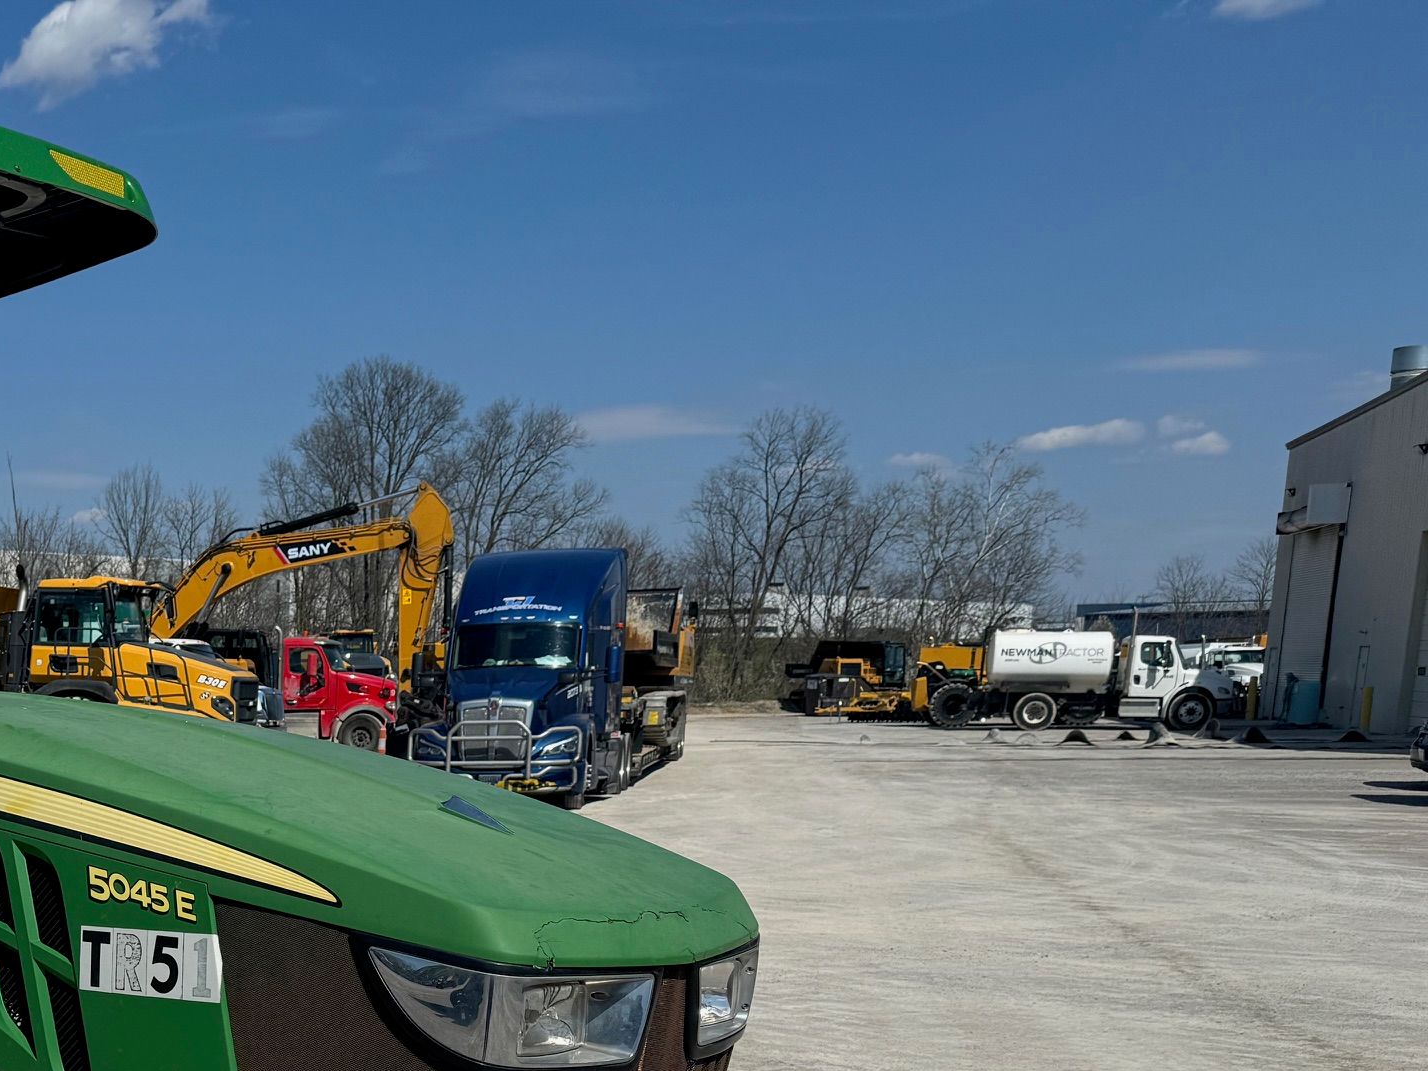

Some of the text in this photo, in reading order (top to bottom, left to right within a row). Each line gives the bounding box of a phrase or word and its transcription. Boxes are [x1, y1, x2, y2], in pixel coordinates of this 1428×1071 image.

[287, 541, 332, 560] SANY
[474, 603, 563, 616] TRANSPORTATION
[197, 674, 228, 689] B30E
[88, 865, 197, 923] 5045 E
